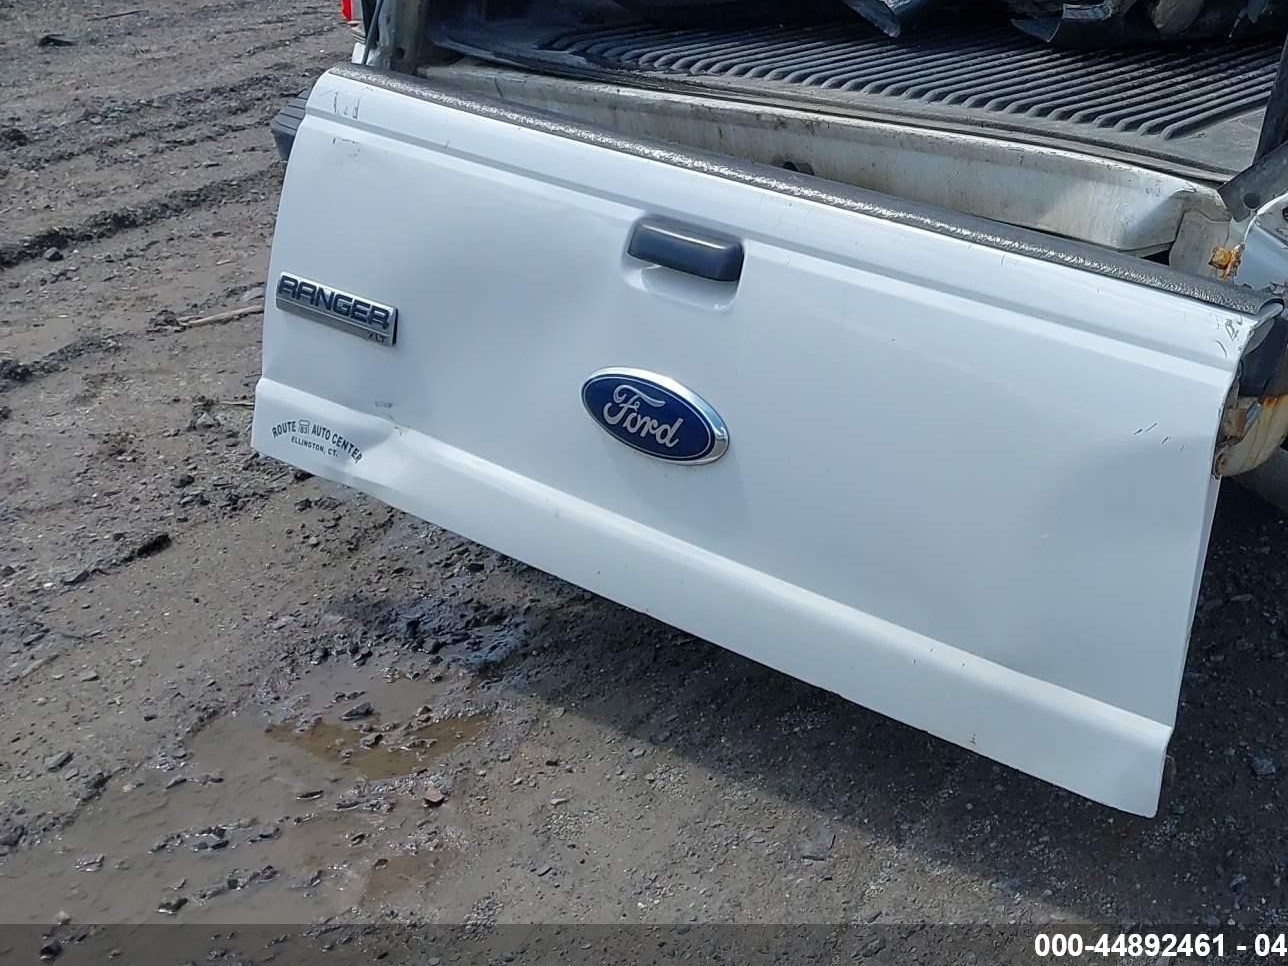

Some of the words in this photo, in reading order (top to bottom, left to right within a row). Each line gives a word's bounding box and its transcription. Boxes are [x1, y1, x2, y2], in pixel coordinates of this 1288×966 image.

[278, 274, 391, 330] RANGER
[603, 384, 684, 448] Ford
[271, 420, 297, 439] ROUTE
[311, 424, 331, 441] AUTO
[331, 433, 363, 465] CENTER
[327, 448, 339, 458] CT.
